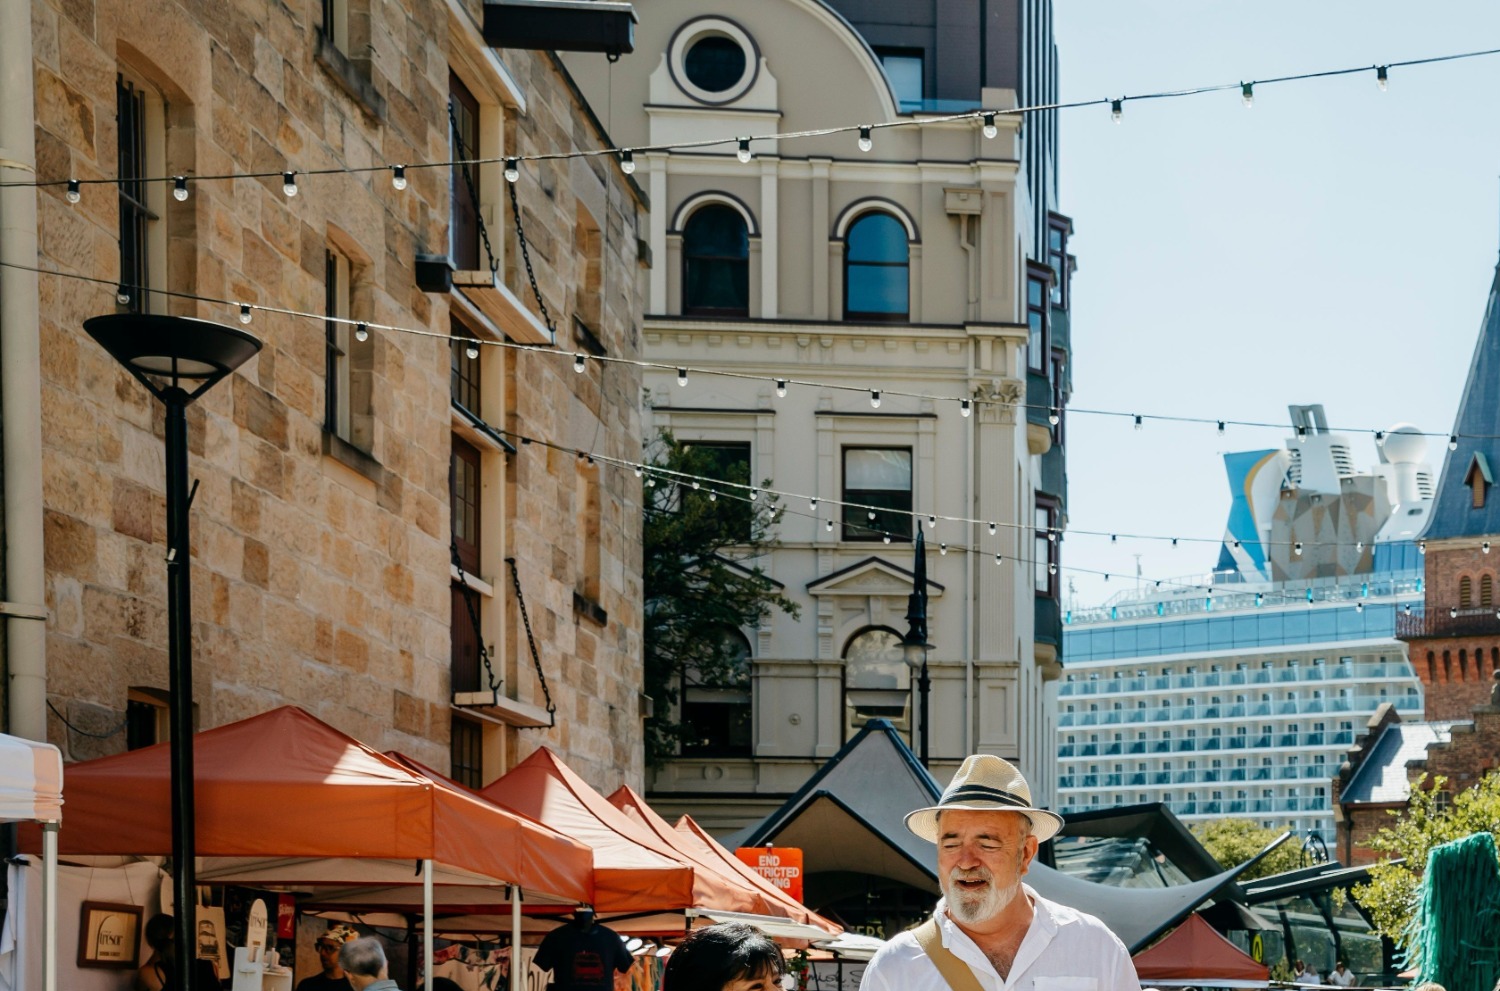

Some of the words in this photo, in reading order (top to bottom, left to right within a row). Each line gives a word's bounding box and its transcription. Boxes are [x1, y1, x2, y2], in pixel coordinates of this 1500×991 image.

[758, 855, 780, 866] END
[751, 867, 800, 878] STRICTED
[767, 877, 791, 889] KING
